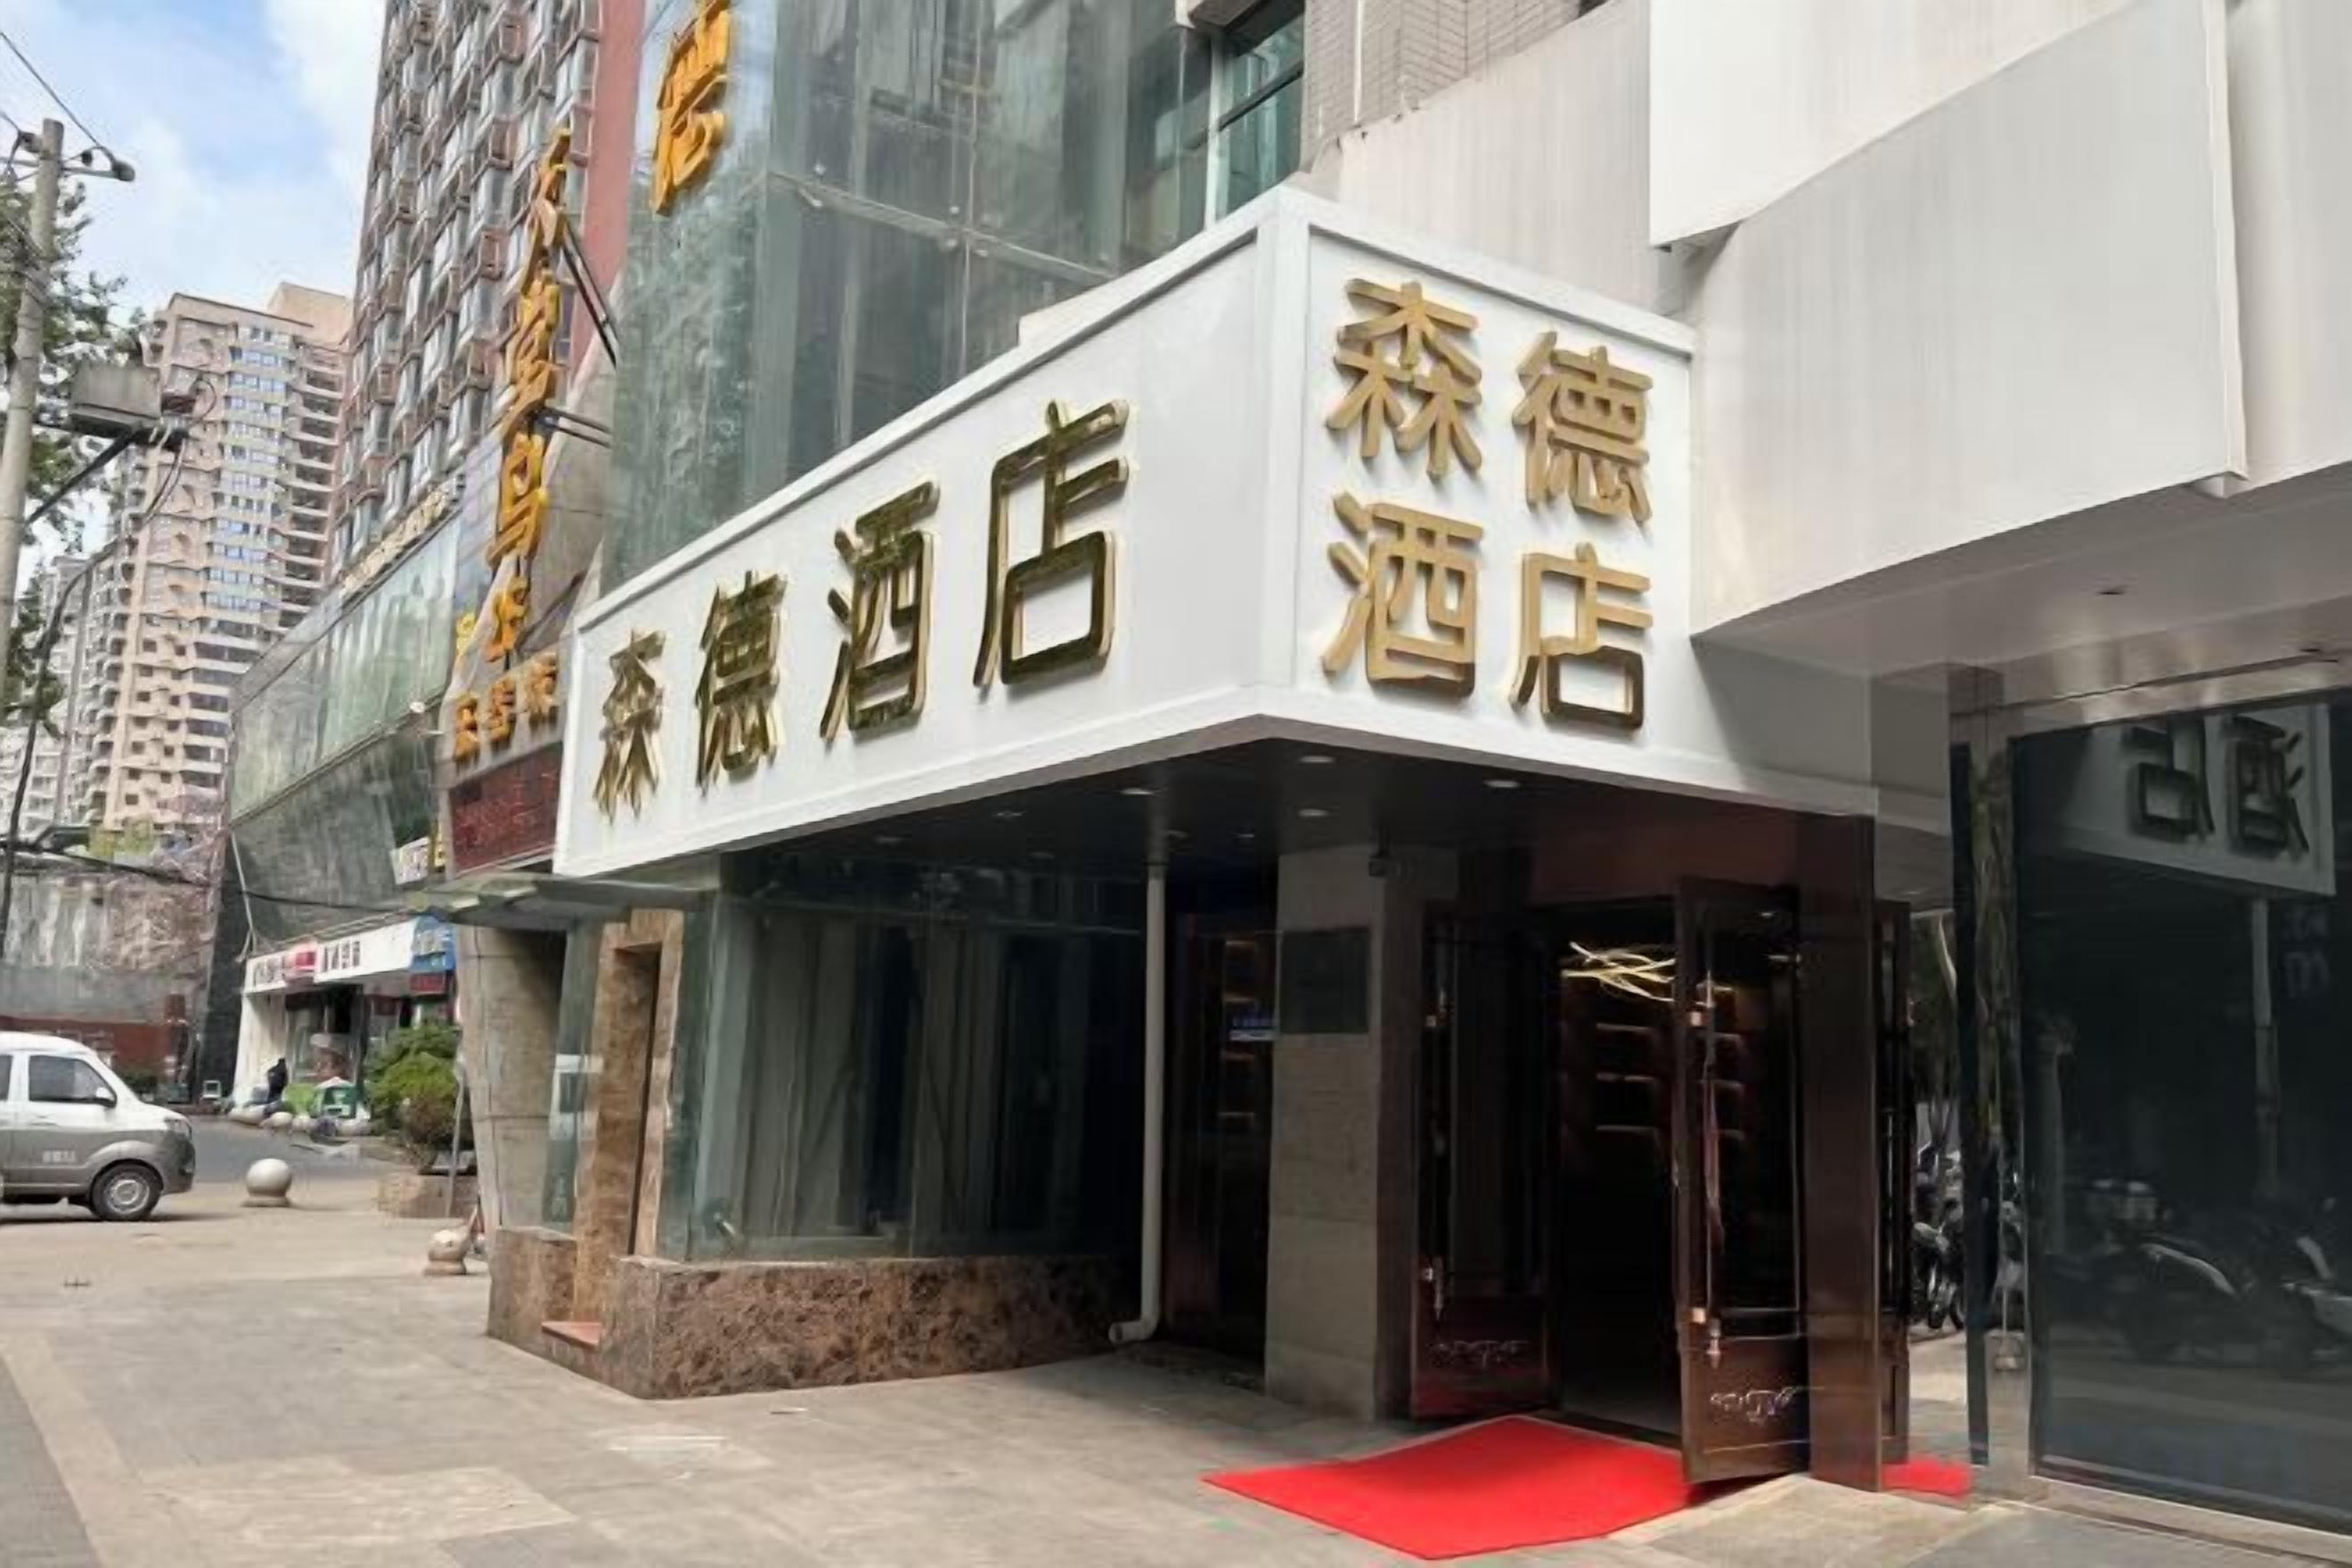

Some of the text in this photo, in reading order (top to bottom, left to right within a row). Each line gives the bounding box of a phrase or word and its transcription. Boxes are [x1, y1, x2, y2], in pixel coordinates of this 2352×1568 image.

[1327, 279, 1654, 524] 森德
[594, 399, 1130, 825] 森德酒店
[1321, 492, 1654, 731] 酒店
